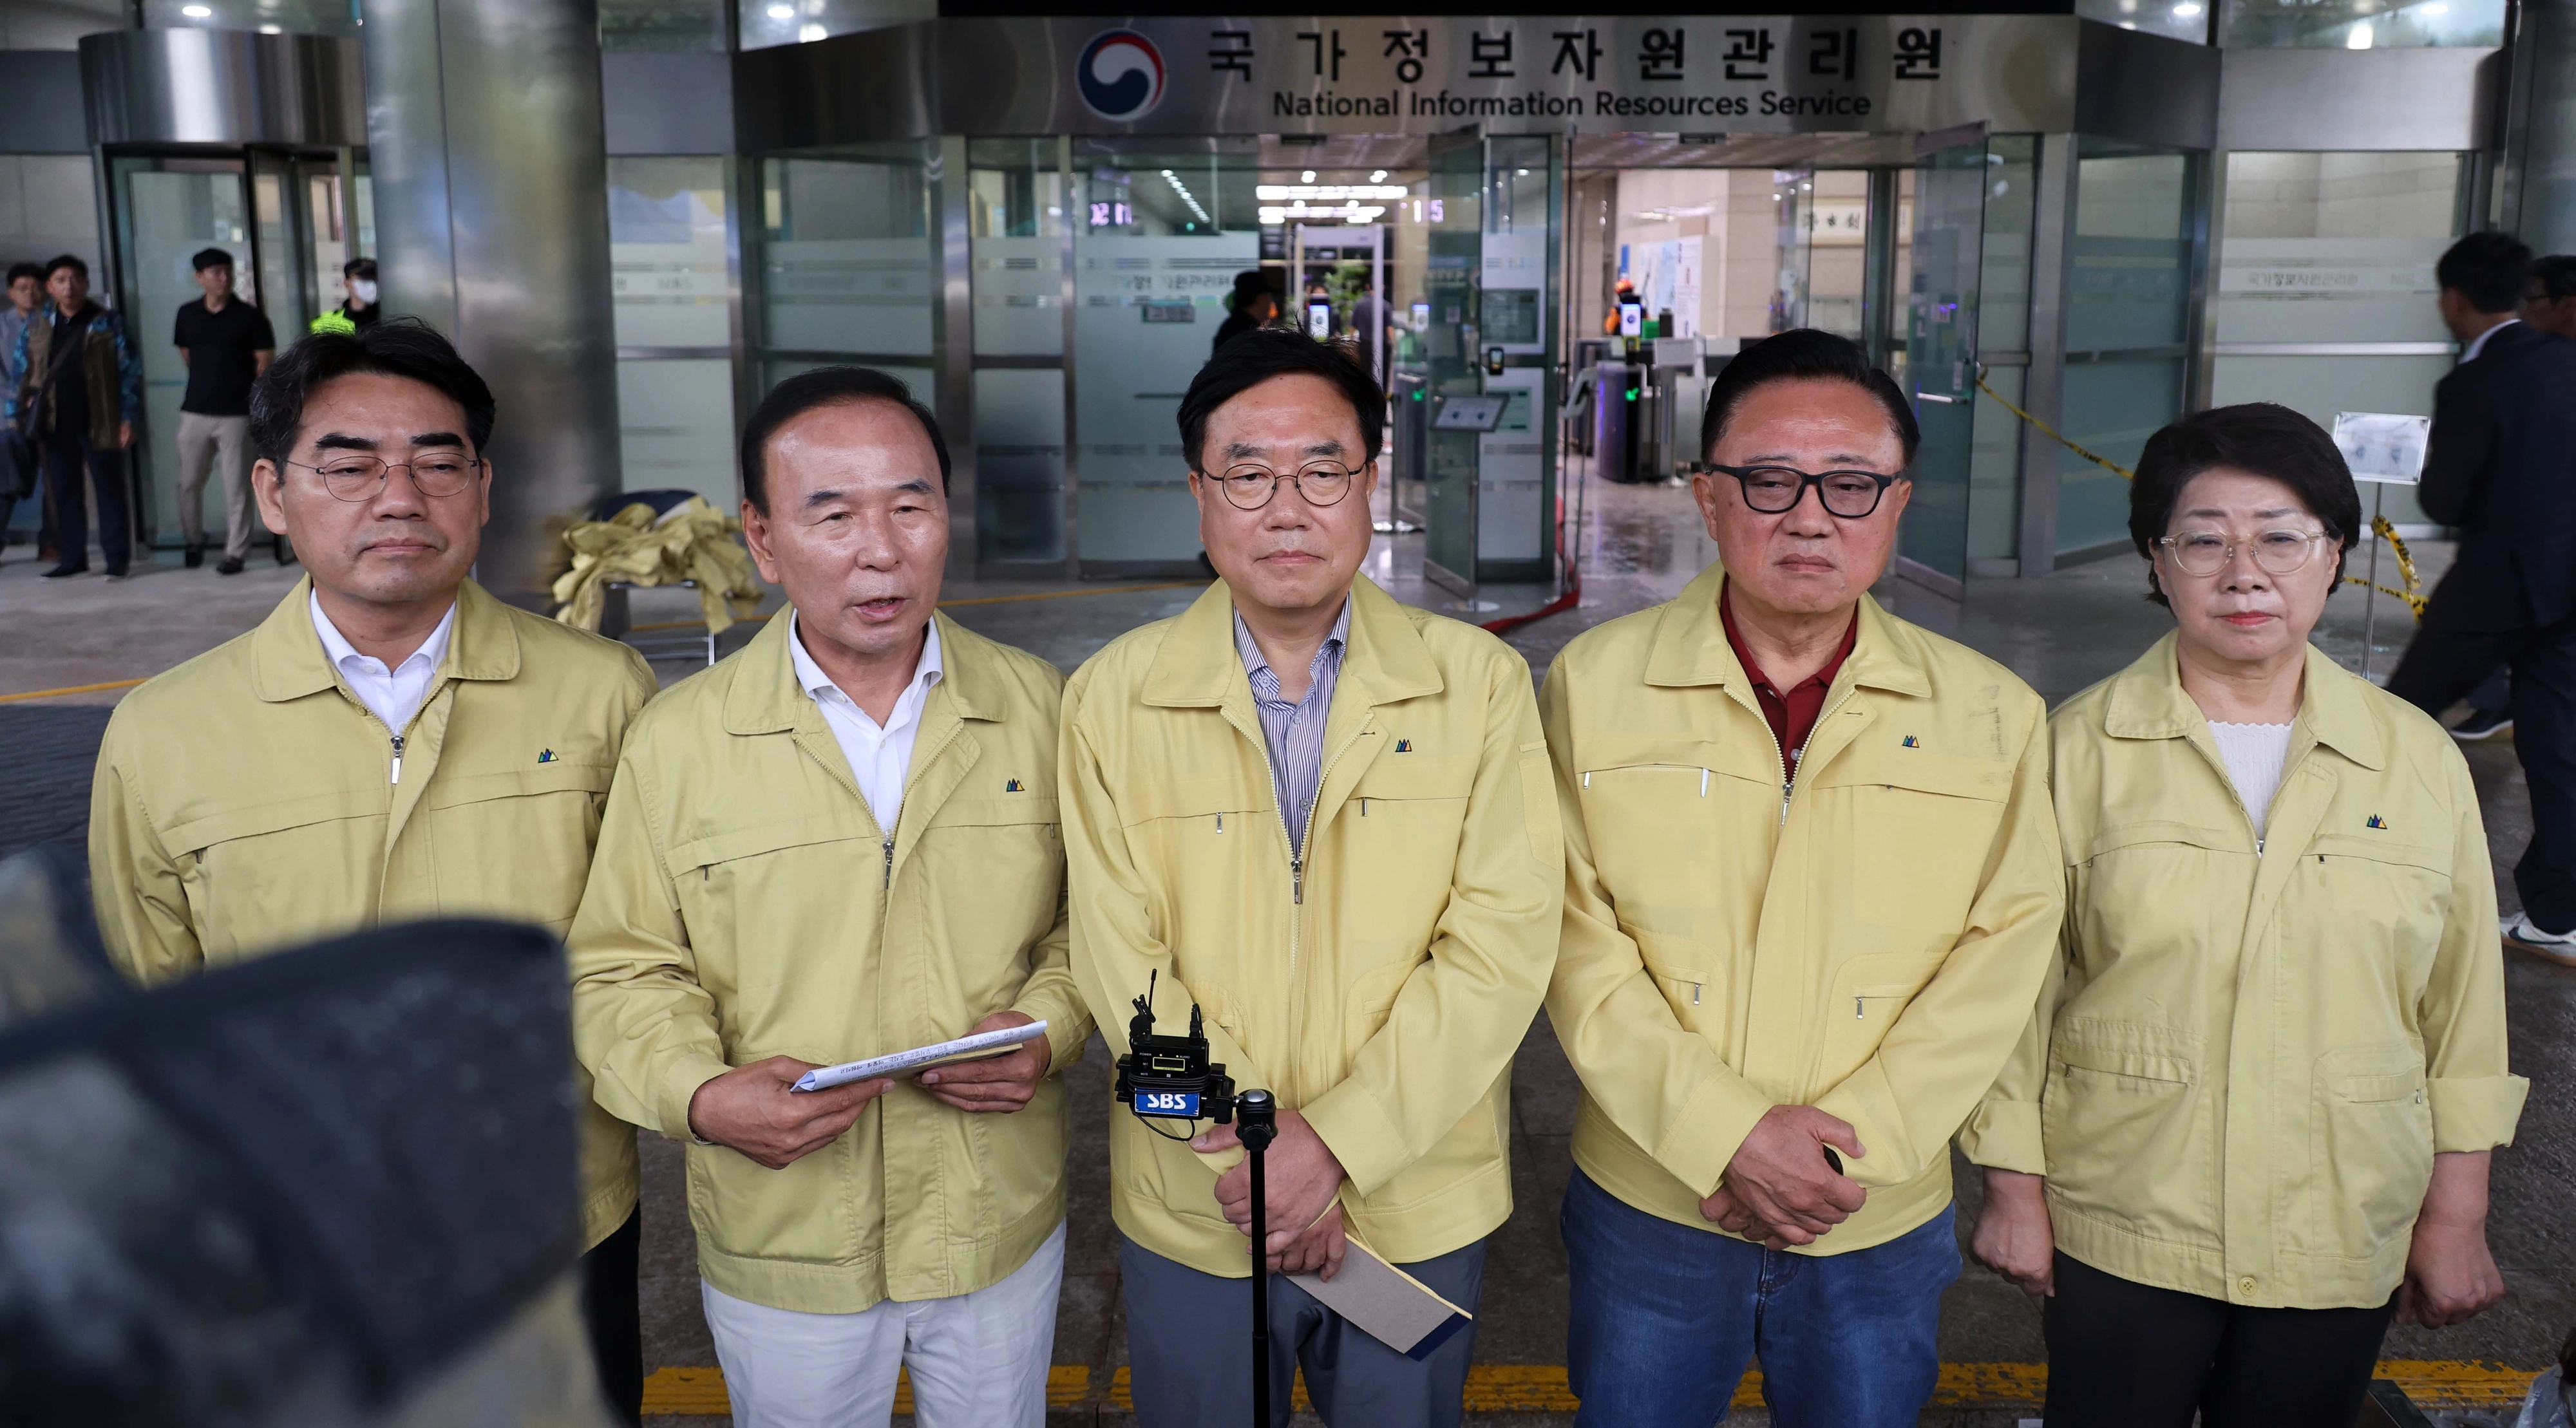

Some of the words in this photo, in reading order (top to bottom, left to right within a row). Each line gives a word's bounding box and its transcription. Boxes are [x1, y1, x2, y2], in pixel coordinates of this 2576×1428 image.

[1208, 28, 1942, 82] 국가정보자원관리원
[1273, 90, 1398, 117] National
[1411, 90, 1583, 117] Information
[1595, 89, 1748, 116] Resources
[1759, 89, 1871, 116] Service
[1147, 1093, 1186, 1110] SBS
